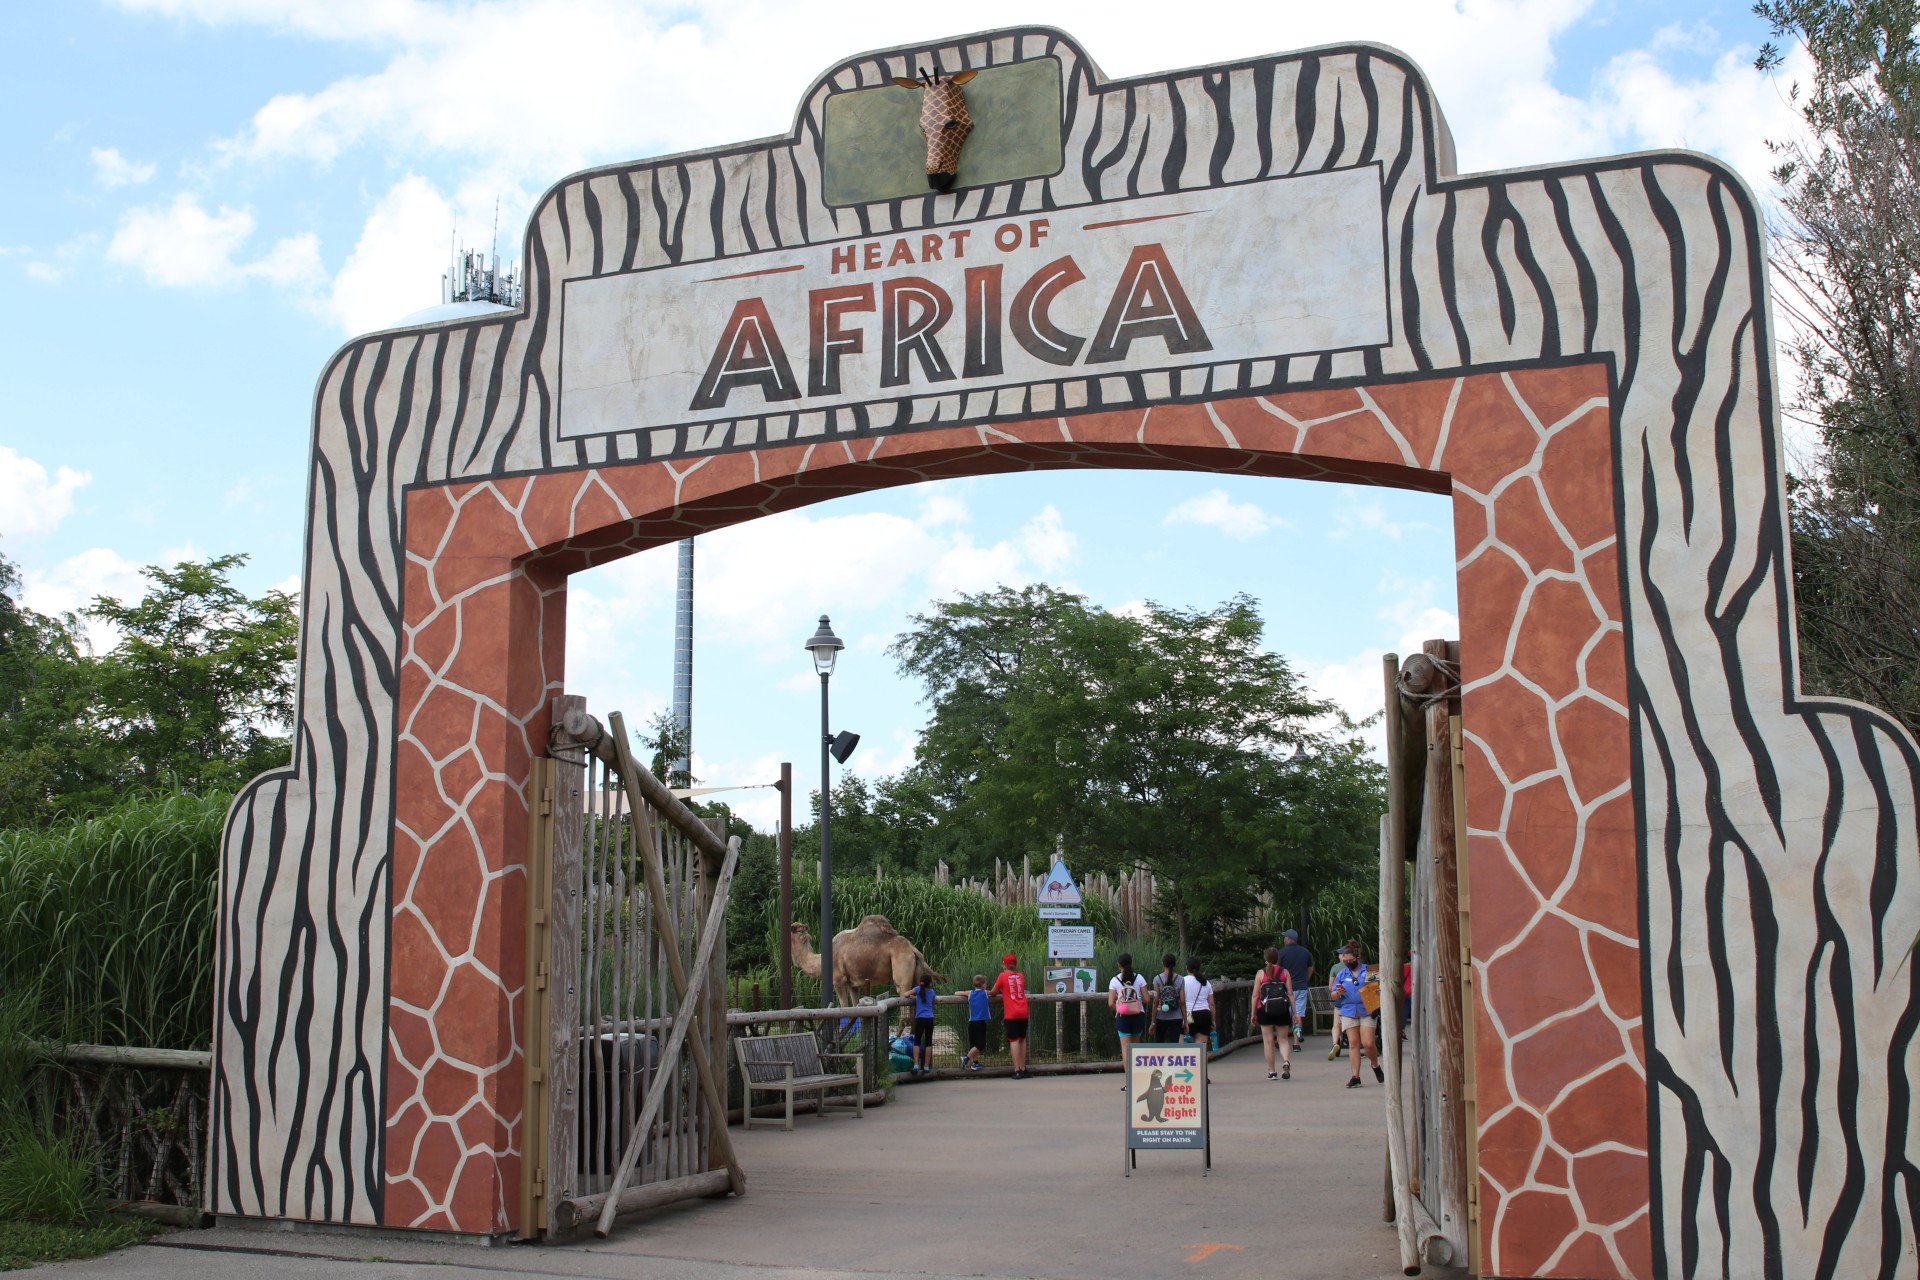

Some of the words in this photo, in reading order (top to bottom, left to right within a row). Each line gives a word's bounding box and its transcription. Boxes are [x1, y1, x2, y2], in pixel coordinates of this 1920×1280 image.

[831, 229, 971, 275] HEART
[994, 218, 1050, 252] OF
[689, 242, 1214, 411] AFRICA
[1136, 1055, 1165, 1067] STAY
[1167, 1055, 1197, 1067] SAFE
[1166, 1084, 1192, 1095] Keep
[1165, 1096, 1176, 1105] to
[1178, 1095, 1195, 1105] the
[1164, 1108, 1197, 1120] Right!
